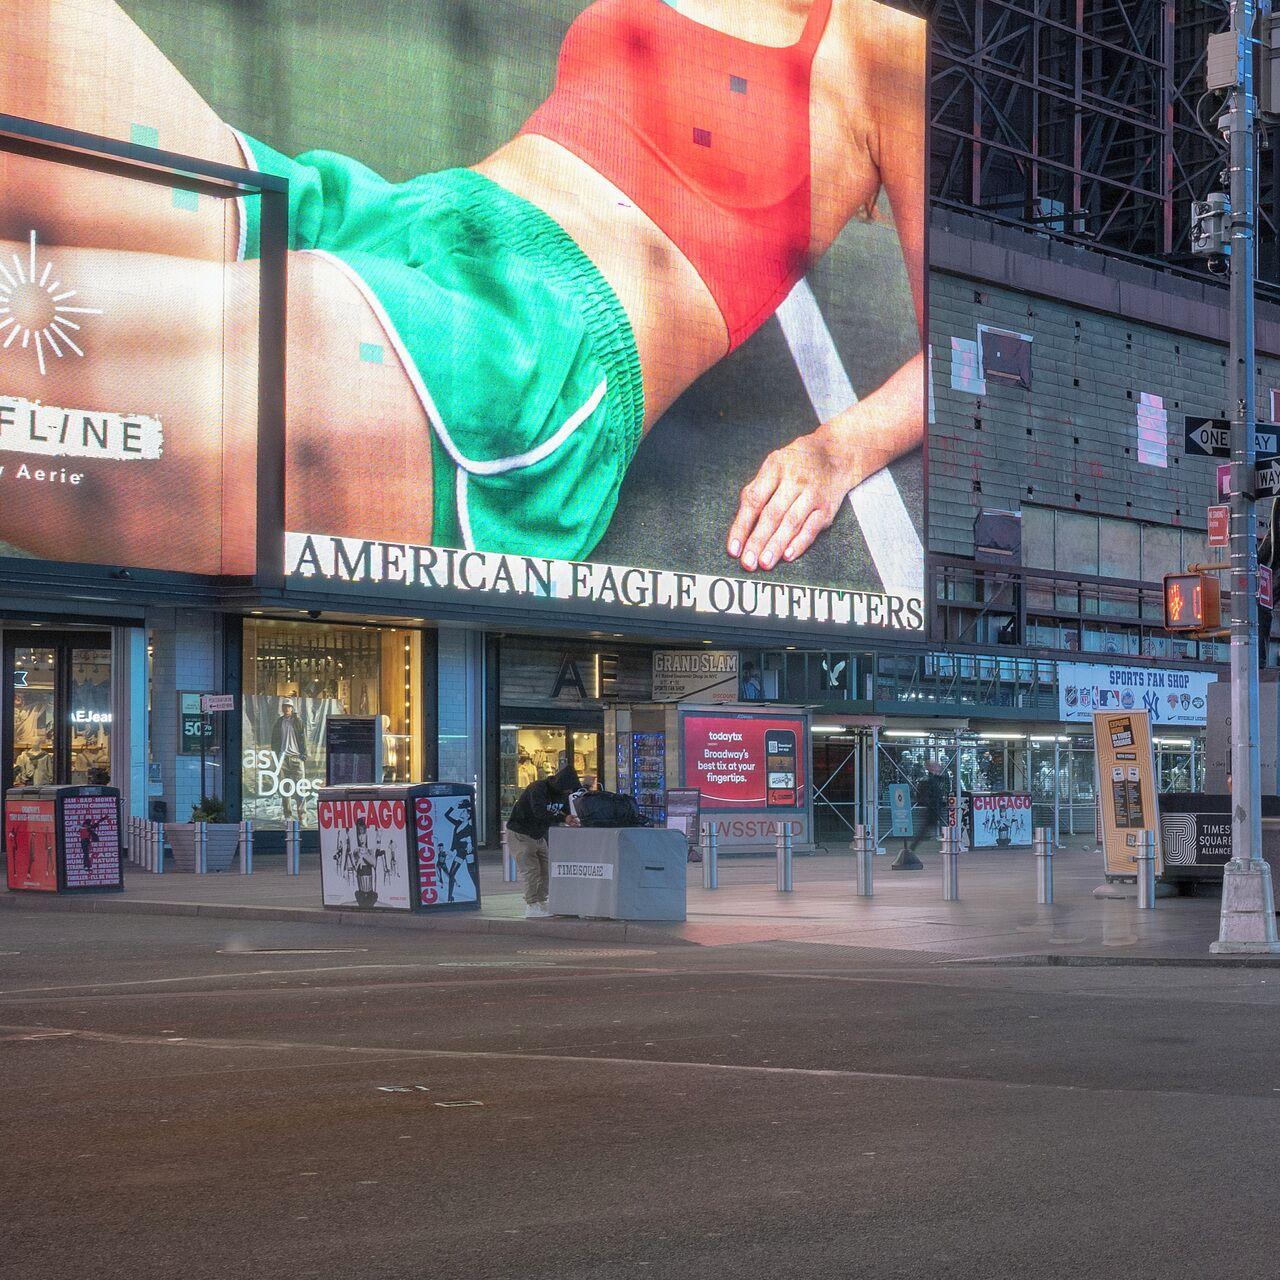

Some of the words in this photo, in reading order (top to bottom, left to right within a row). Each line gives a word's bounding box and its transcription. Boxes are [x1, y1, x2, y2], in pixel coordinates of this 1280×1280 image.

[1200, 429, 1228, 446] ONE
[16, 463, 80, 485] Aerie
[292, 535, 554, 598] AMERICAN
[568, 564, 698, 611] EAGLE
[707, 578, 924, 630] OUTFITTERS
[655, 654, 700, 672] GRAND
[701, 654, 738, 672] SLAM
[1109, 670, 1146, 687] SPORTS
[1147, 672, 1165, 688] FAN
[1167, 673, 1190, 689] SHOP
[708, 731, 743, 742] todaytix
[704, 749, 750, 760] Broadway's
[697, 761, 716, 771] best
[716, 761, 727, 771] tix
[727, 762, 738, 771] at
[738, 762, 755, 773] your
[706, 773, 748, 784] fingertips.
[973, 796, 1032, 811] CHICAGO
[318, 800, 407, 830] CHICAGO
[1202, 824, 1231, 835] TIMES
[1199, 836, 1232, 846] SQUARE
[415, 797, 438, 904] CHICAGO
